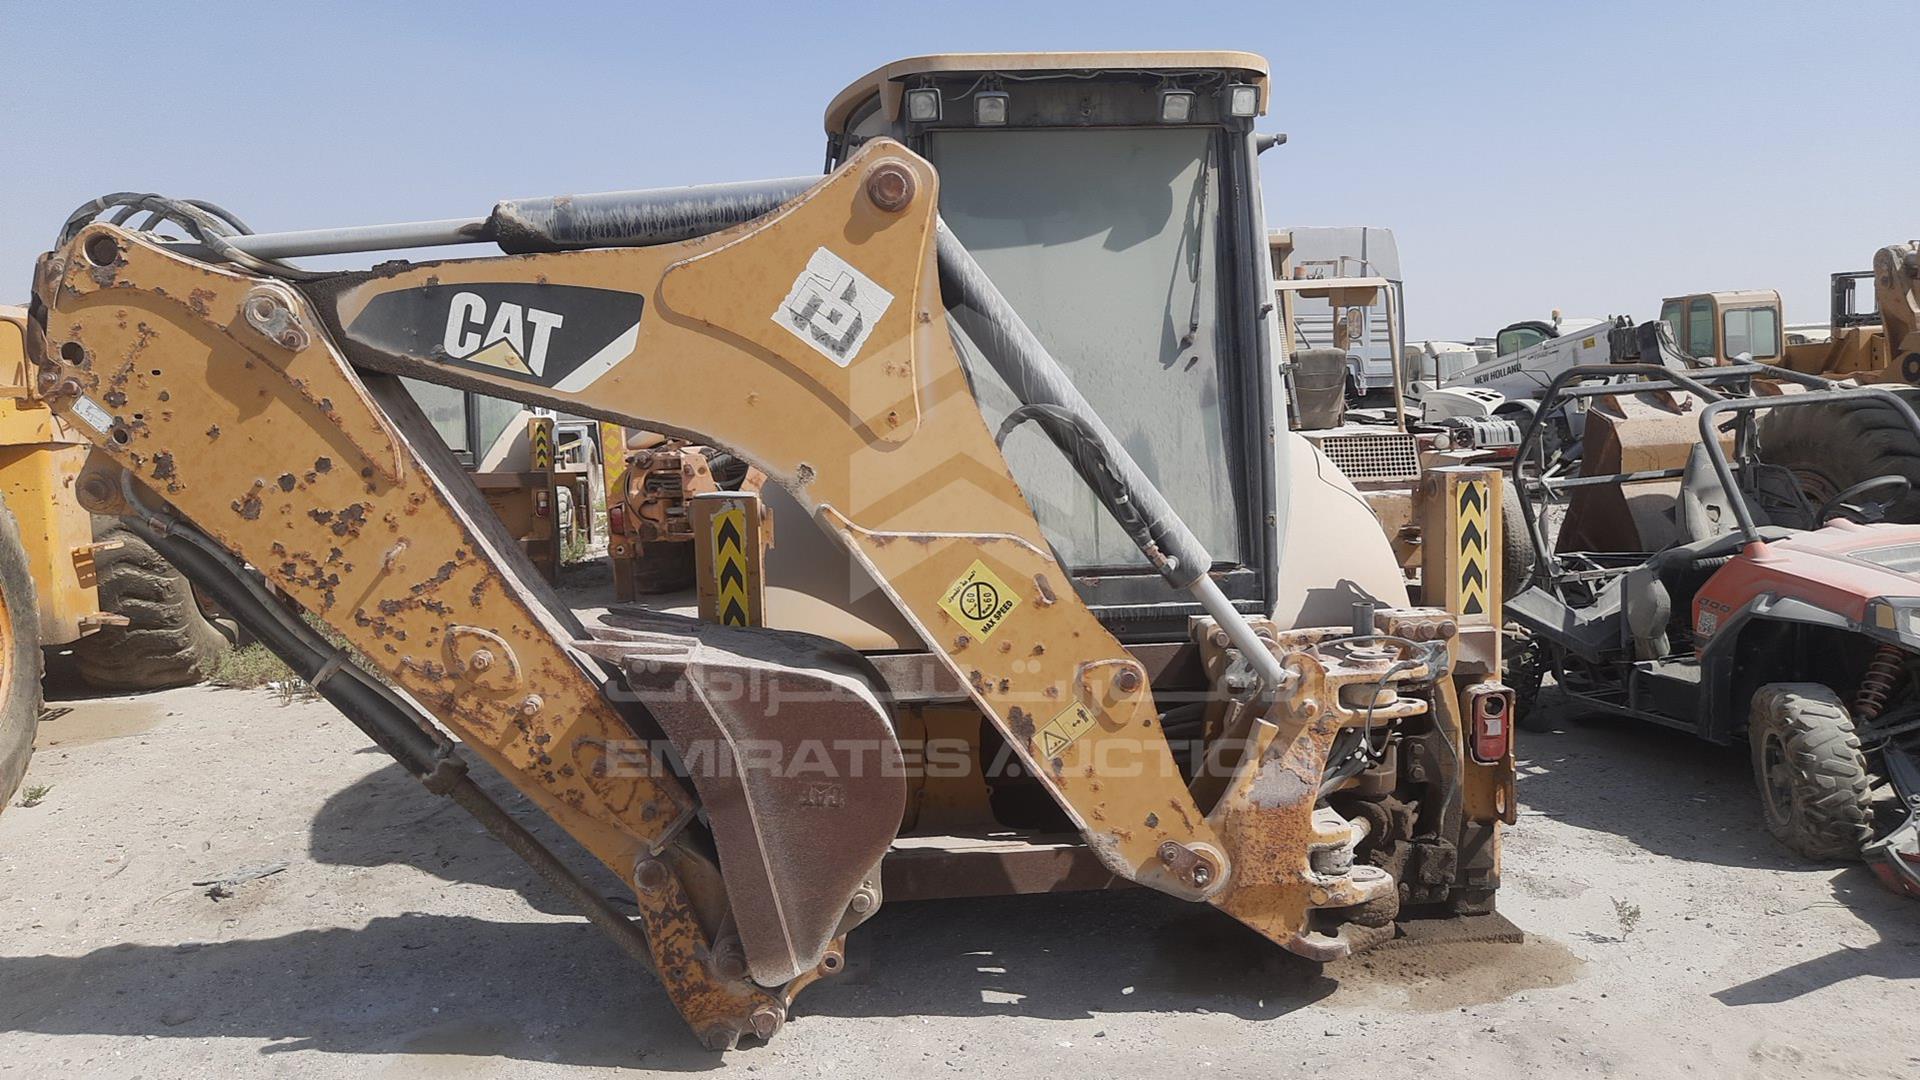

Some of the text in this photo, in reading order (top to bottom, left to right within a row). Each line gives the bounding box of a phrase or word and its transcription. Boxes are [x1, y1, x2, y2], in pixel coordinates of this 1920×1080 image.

[443, 291, 564, 377] CAT
[1474, 363, 1522, 384] NEW HOLLAND
[981, 600, 1013, 634] MAX SPEED
